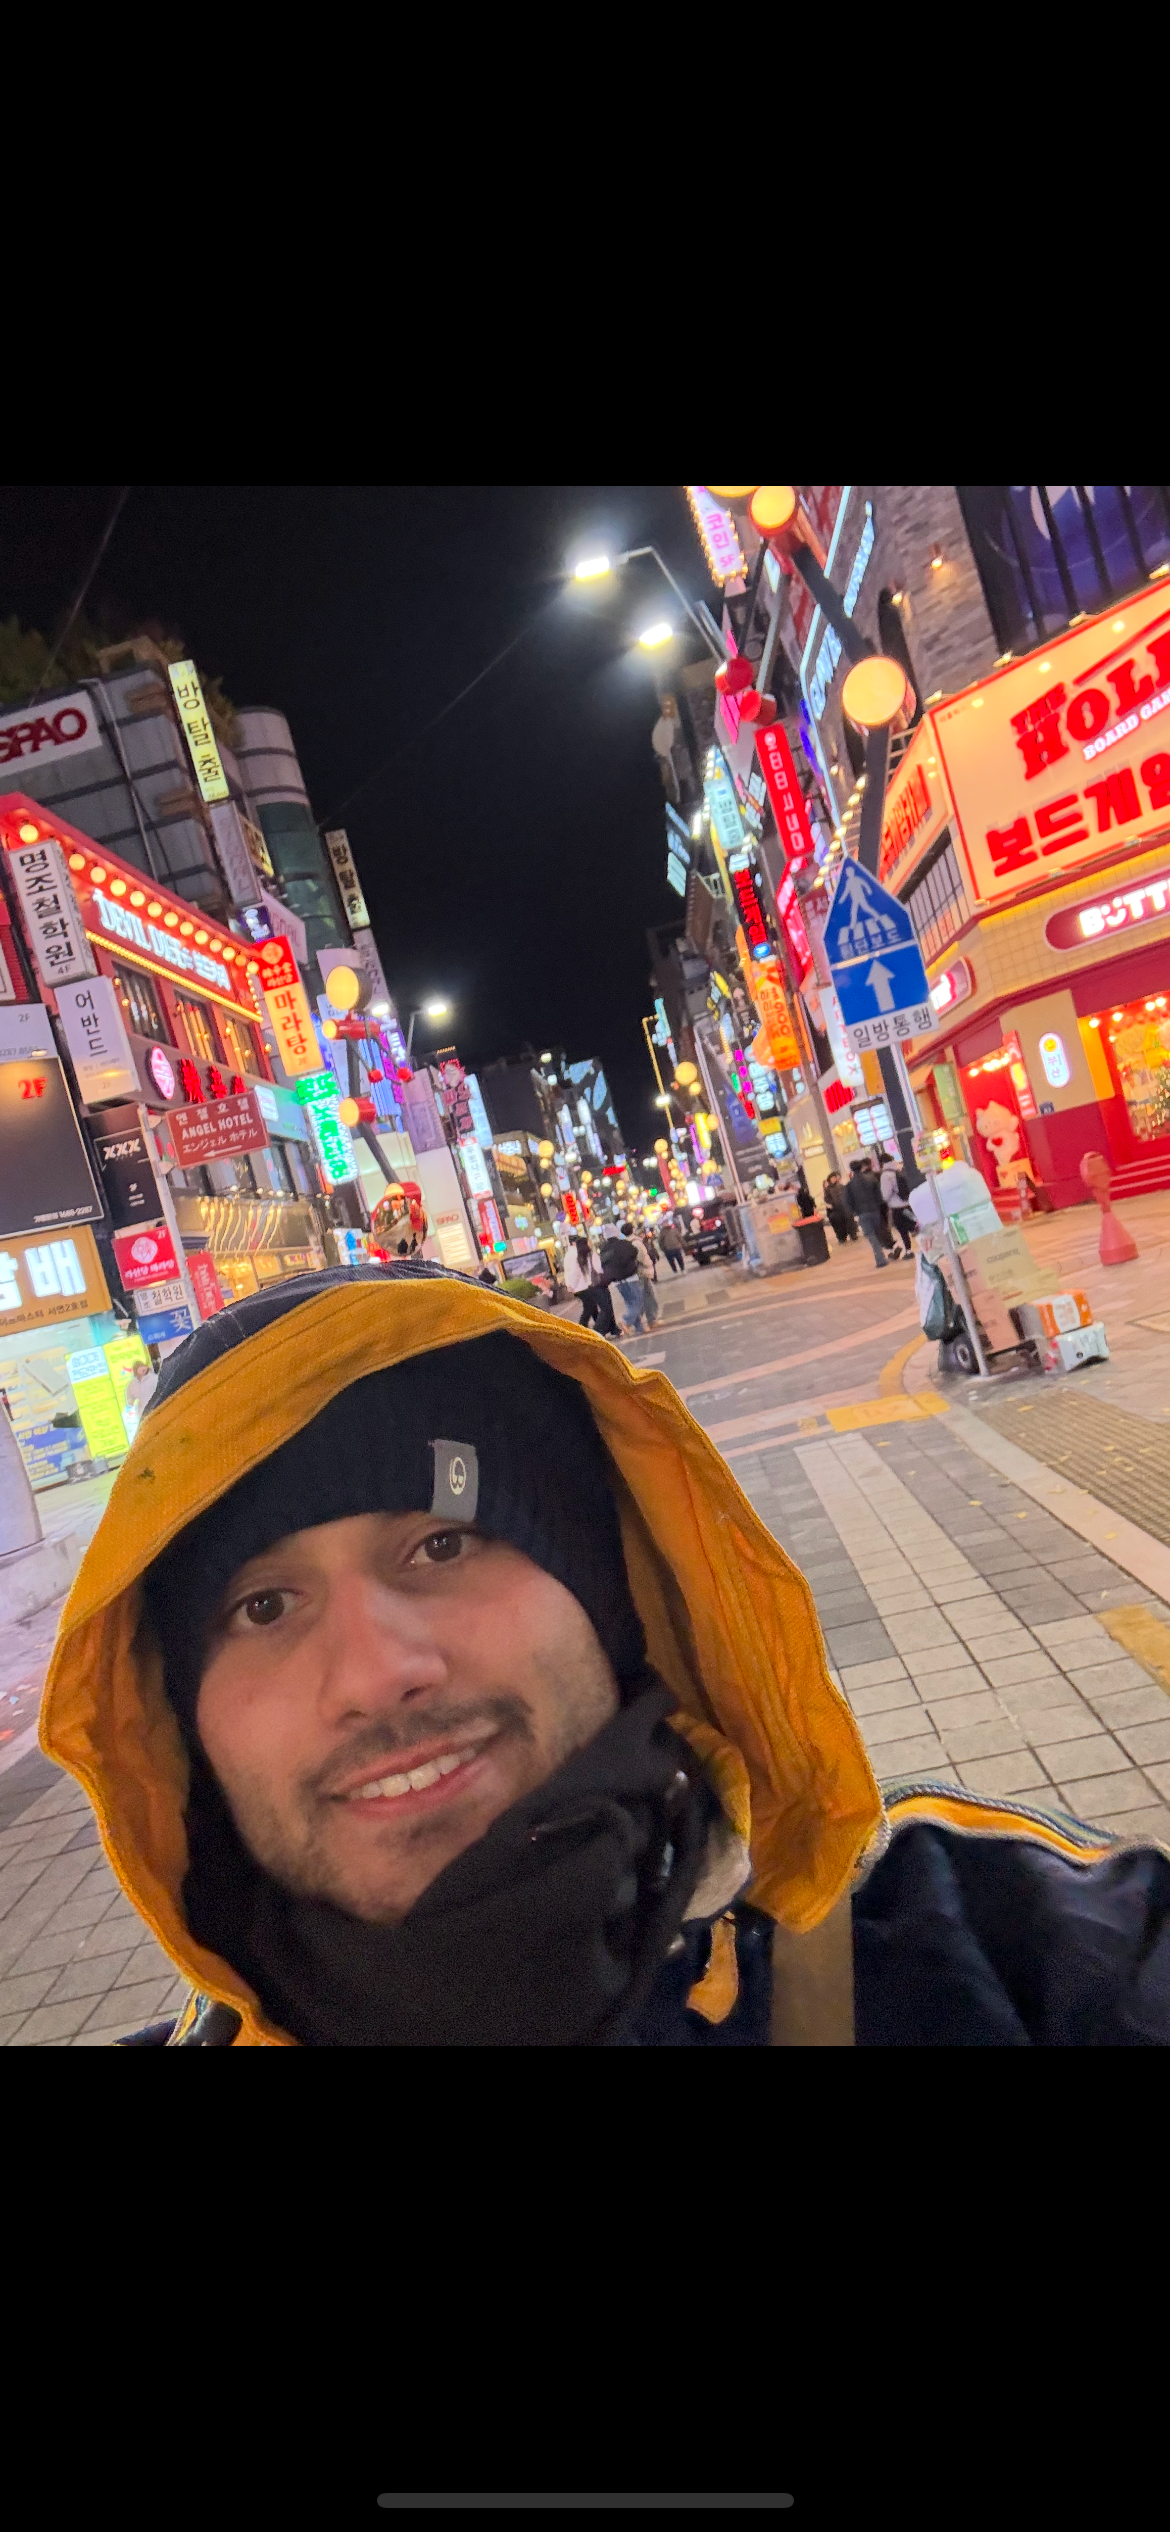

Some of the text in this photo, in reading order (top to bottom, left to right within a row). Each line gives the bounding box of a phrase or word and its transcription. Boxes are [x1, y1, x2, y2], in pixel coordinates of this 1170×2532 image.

[1009, 681, 1067, 735] THE
[0, 707, 88, 764] SPAO
[1083, 713, 1139, 761] BOARD
[20, 849, 76, 966] 명조철학원
[57, 966, 71, 976] 4F
[75, 989, 108, 1057] 어반드
[274, 990, 307, 1055] 마라탕
[853, 1006, 932, 1048] 일방통행
[18, 1077, 47, 1099] 2F
[182, 1113, 254, 1140] ANGEL HOTEL
[152, 1285, 184, 1305] 철학원
[170, 1309, 192, 1332] 꽃
